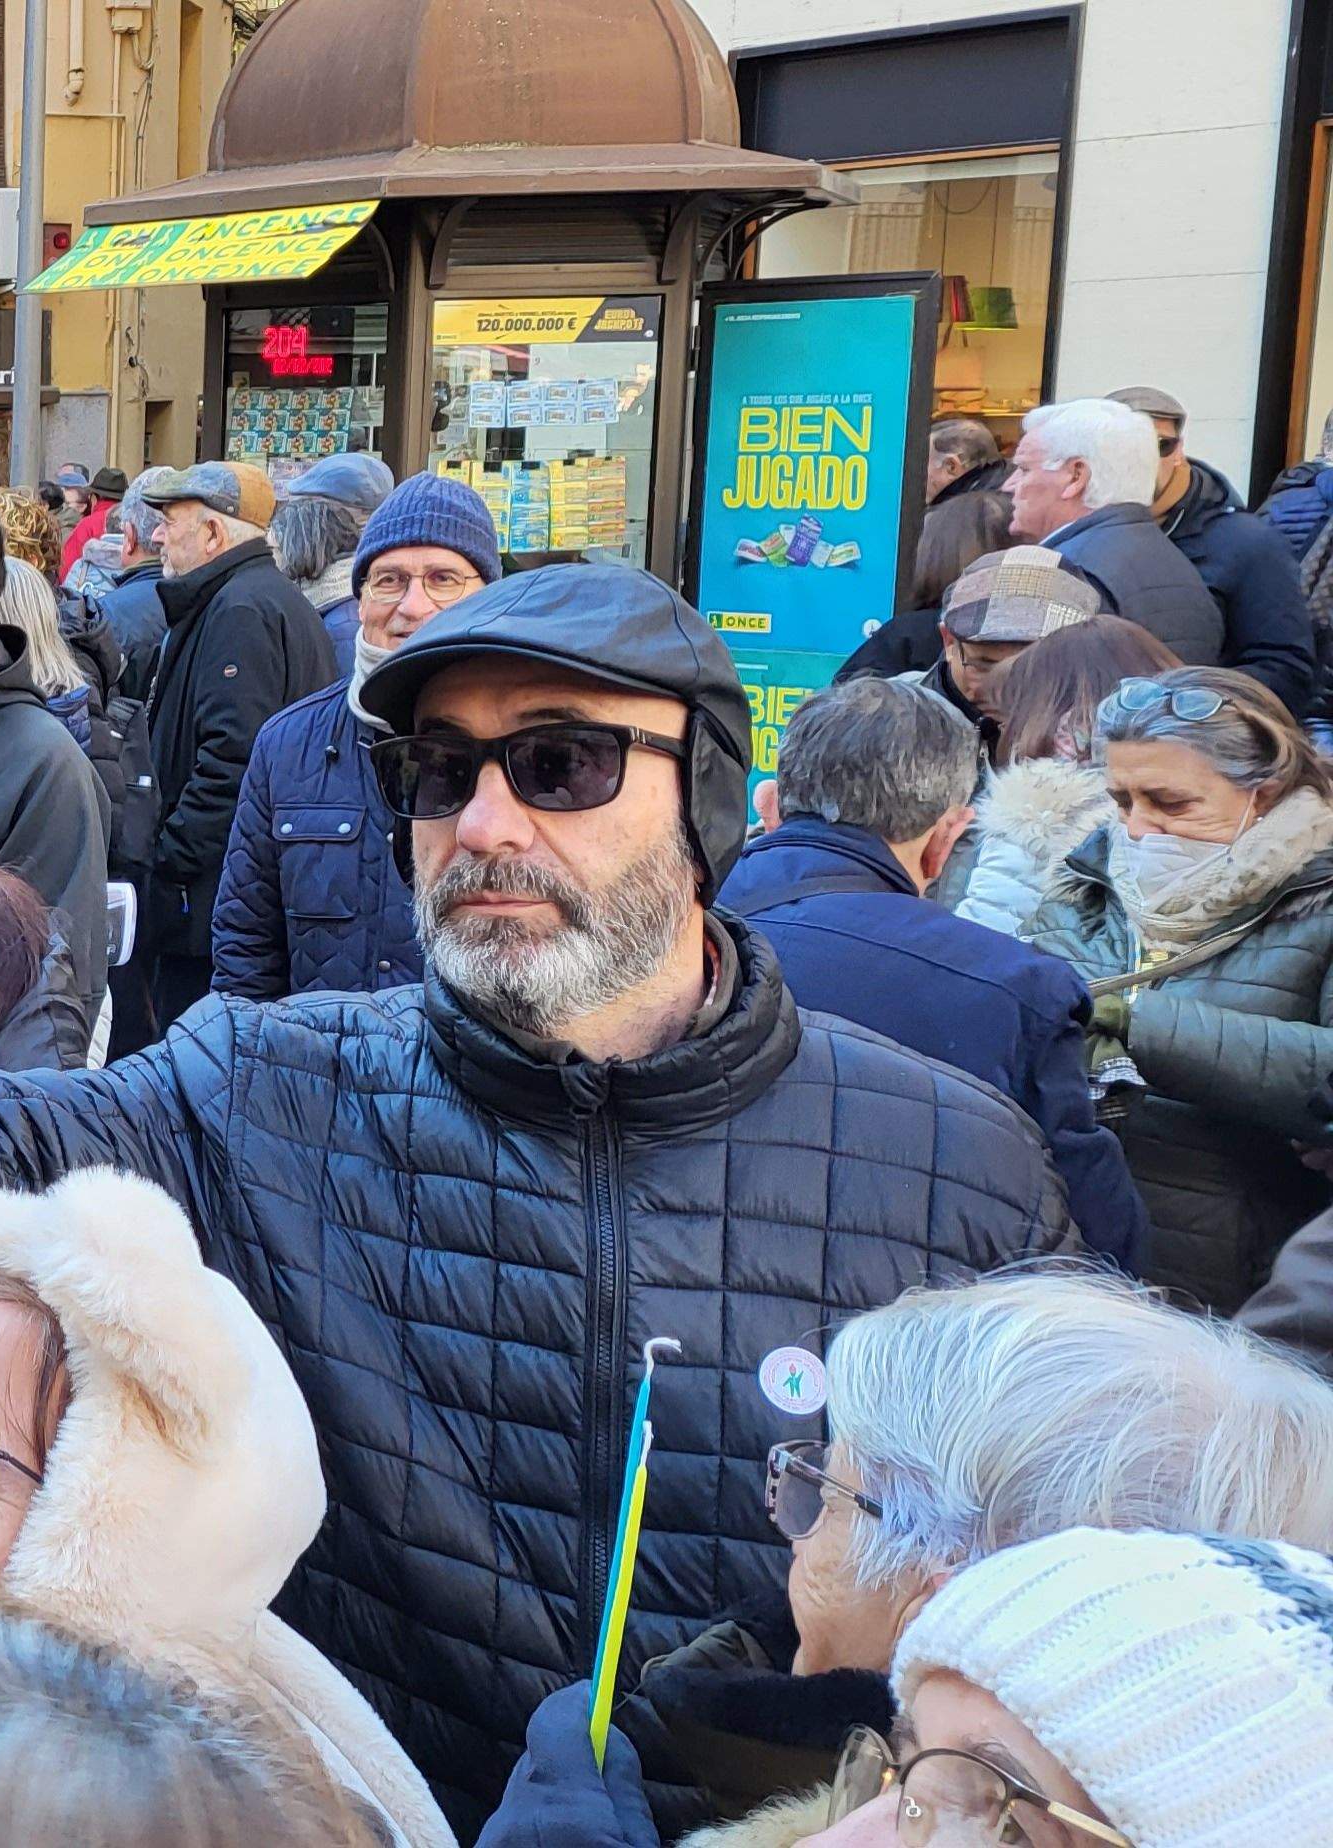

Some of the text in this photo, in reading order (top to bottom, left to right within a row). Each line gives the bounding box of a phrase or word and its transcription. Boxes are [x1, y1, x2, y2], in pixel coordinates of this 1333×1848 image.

[262, 325, 308, 358] 204
[476, 316, 578, 332] 120.000.000 €
[738, 405, 873, 453] BIEN
[722, 454, 869, 511] JUGADO
[726, 615, 767, 629] ONCE
[742, 684, 817, 726] BIE
